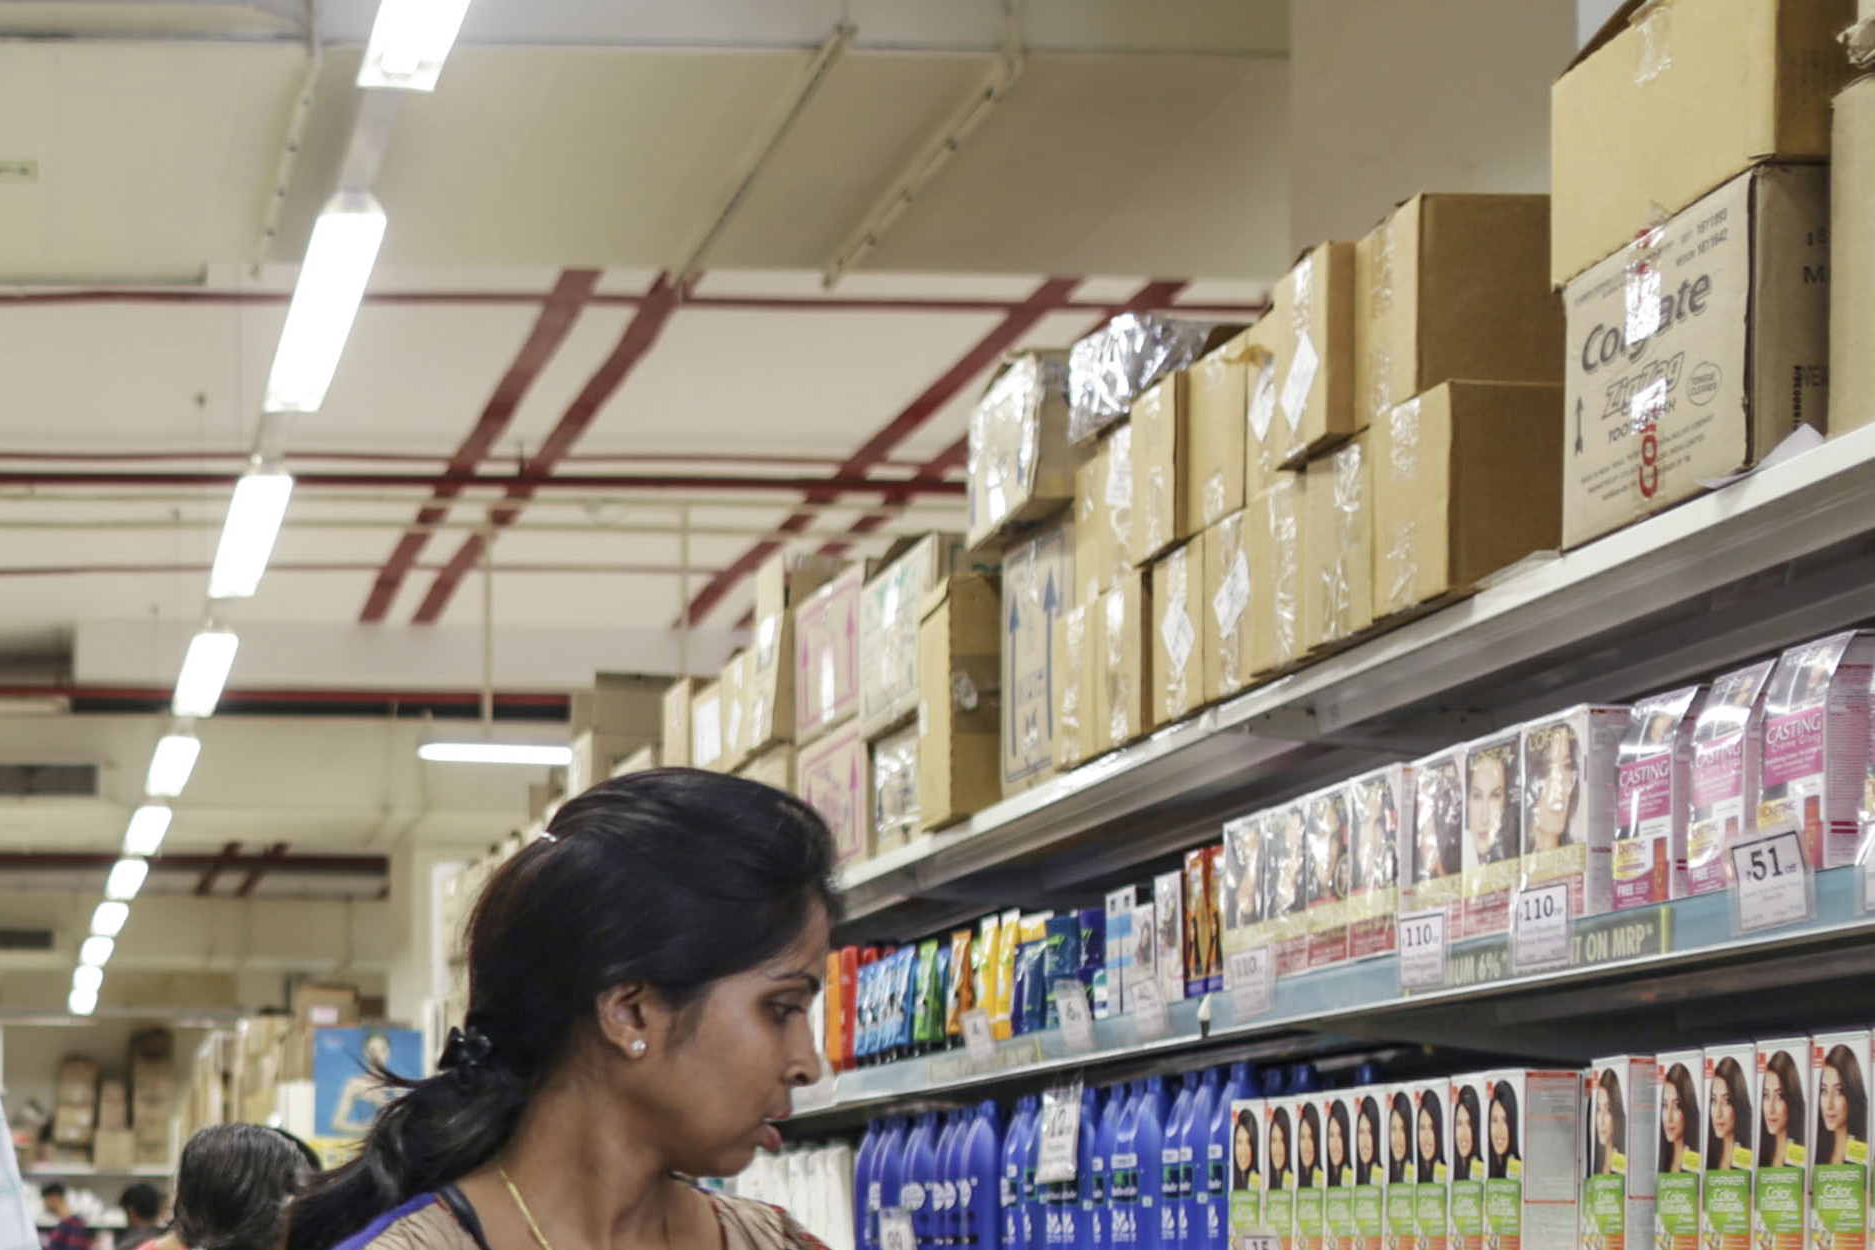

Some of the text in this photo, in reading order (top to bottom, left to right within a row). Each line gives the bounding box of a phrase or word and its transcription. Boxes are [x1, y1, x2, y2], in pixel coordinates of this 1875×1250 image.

[1766, 714, 1822, 745] CASTING
[1619, 759, 1670, 789] CASTING
[1691, 867, 1709, 881] FREE
[1616, 883, 1635, 898] FREE
[1709, 1176, 1745, 1186] GARNIER
[1761, 1173, 1799, 1184] GARNIER
[1818, 1170, 1861, 1182] GARNIER
[1659, 1178, 1694, 1189] GARNIER
[1664, 1190, 1688, 1203] Color
[1713, 1188, 1739, 1201] Color
[1766, 1186, 1793, 1200] Color
[1824, 1184, 1854, 1199] Color
